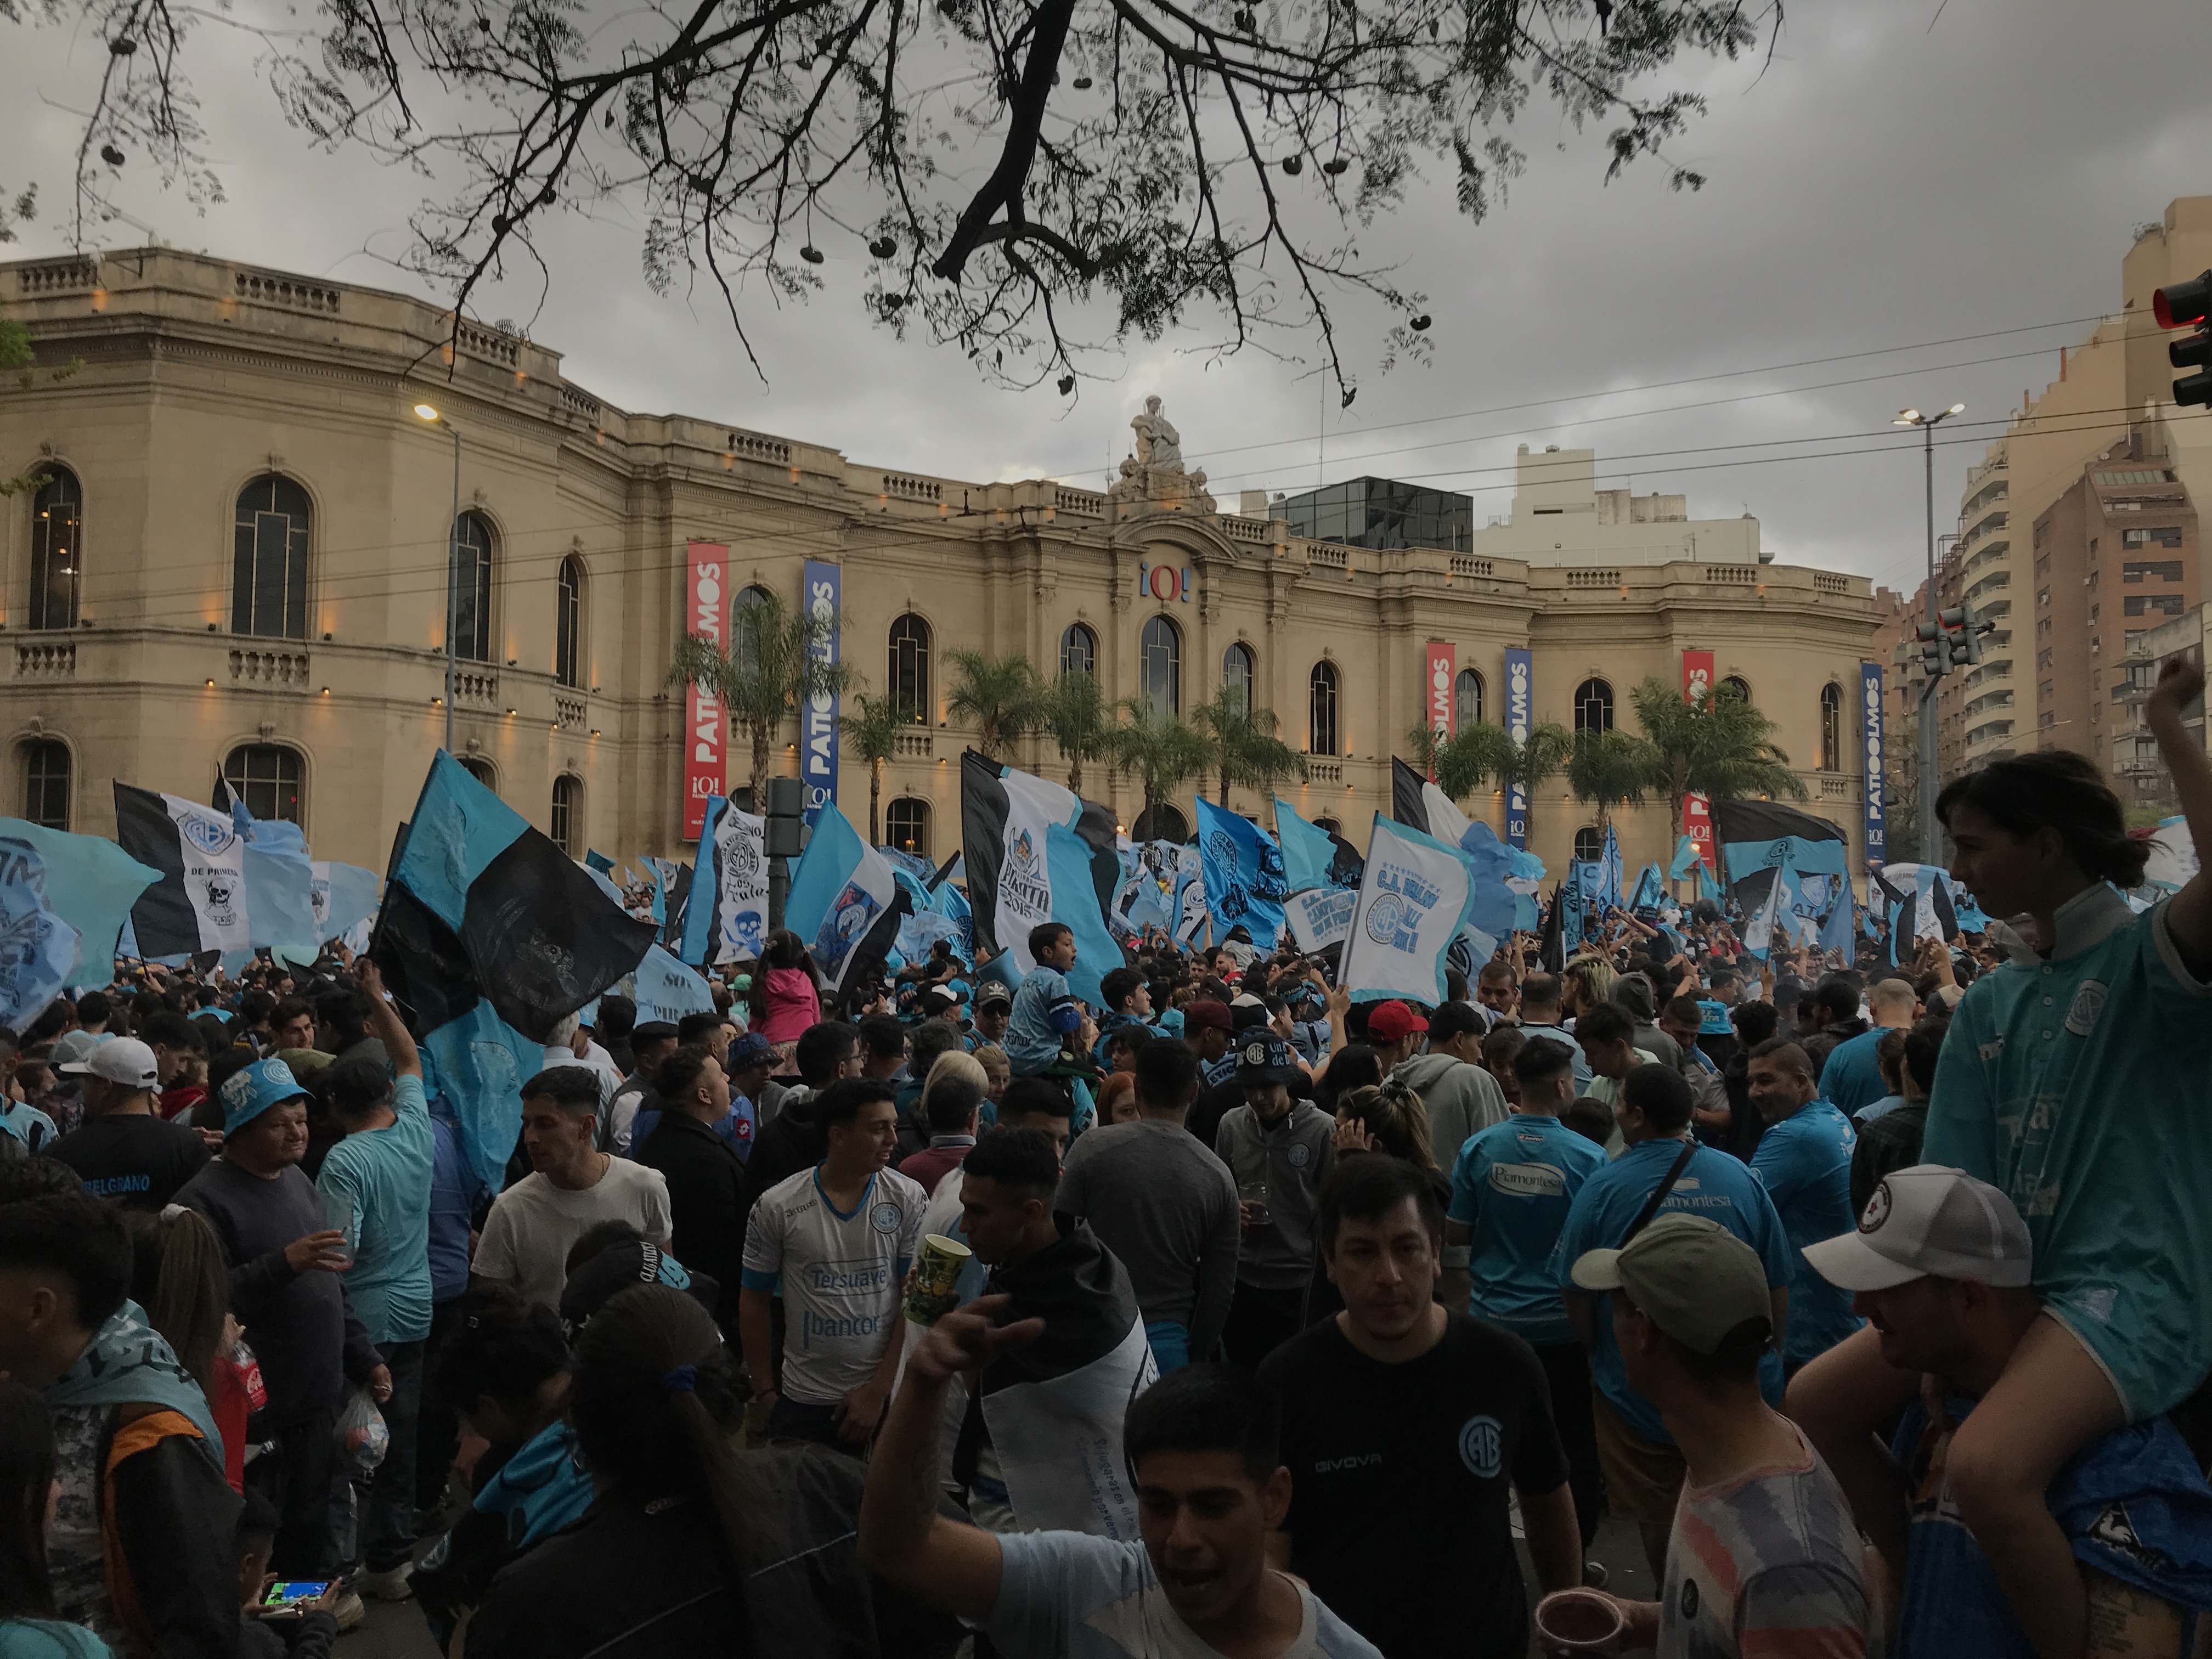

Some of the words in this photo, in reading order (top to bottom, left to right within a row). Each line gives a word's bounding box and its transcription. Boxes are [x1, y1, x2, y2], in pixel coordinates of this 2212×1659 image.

[696, 561, 720, 763] PATIOLMOS
[810, 581, 833, 775] PATIOLMOS
[191, 867, 204, 876] DE
[207, 867, 239, 877] PRIMERA
[1000, 859, 1049, 913] PIRATA
[1005, 891, 1032, 919] 2015
[83, 1174, 150, 1195] BELGRANO
[1494, 1167, 1563, 1188] Piamontesa
[1646, 1190, 1731, 1207] amontesa
[812, 1269, 886, 1288] Tersuave
[812, 1312, 880, 1337] bancor
[1315, 1453, 1383, 1474] GIVOVA
[1114, 1493, 1125, 1505] en
